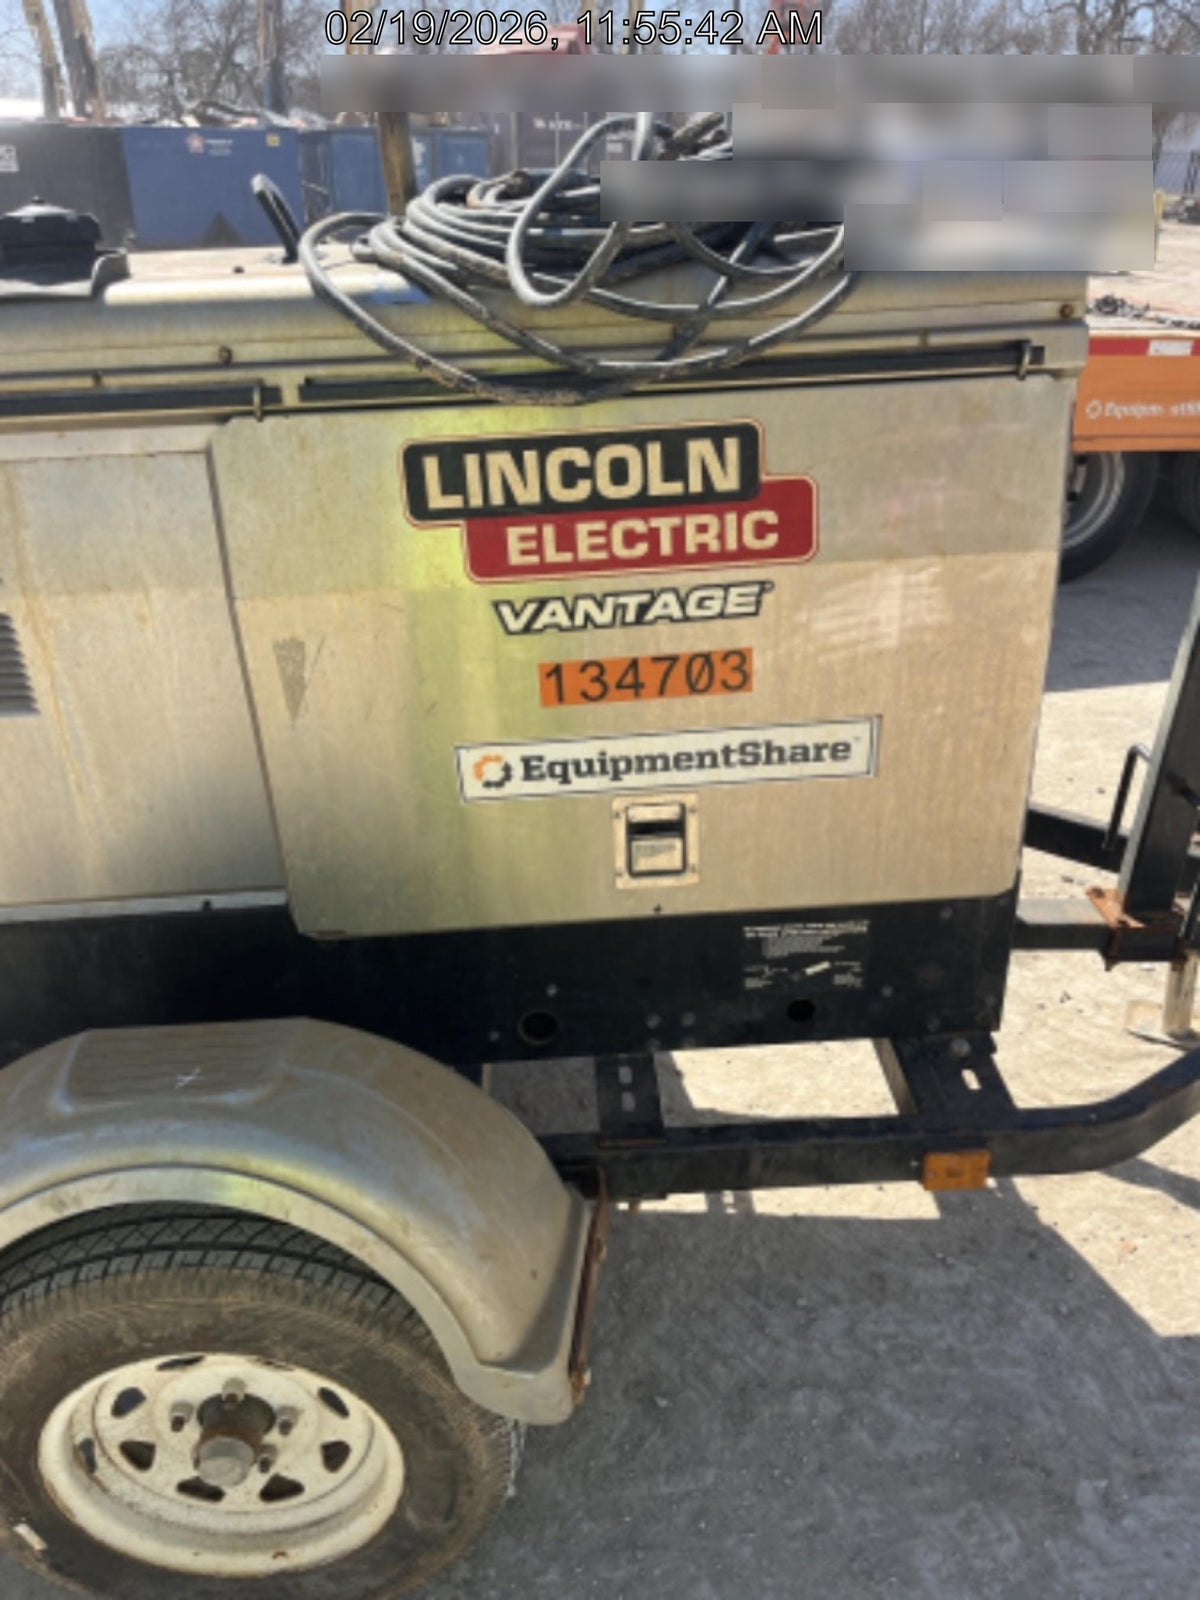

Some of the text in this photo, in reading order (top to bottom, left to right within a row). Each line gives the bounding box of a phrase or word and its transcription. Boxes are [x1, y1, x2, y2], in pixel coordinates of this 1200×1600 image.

[422, 437, 741, 510] LINCOLN
[506, 511, 779, 566] ELECTRIC
[493, 582, 767, 634] VANTAGE
[545, 650, 749, 704] 134703
[520, 740, 852, 784] EquipmentShare
